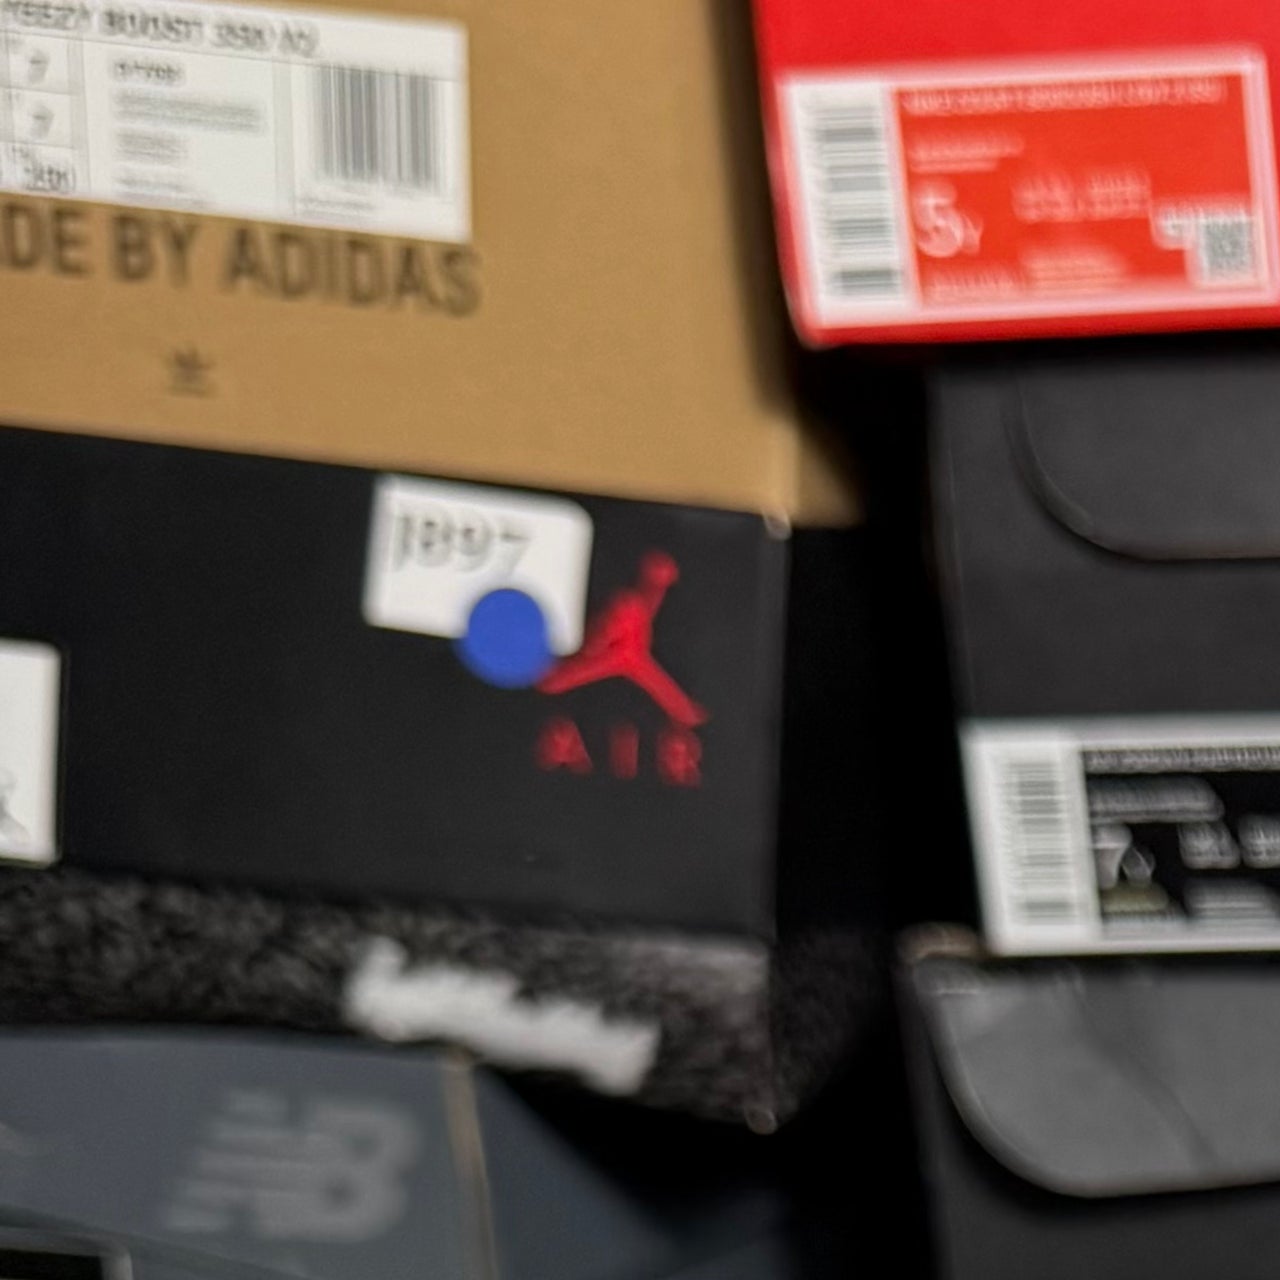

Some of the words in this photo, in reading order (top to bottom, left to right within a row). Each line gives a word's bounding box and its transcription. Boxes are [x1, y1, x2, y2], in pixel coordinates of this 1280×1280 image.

[112, 212, 198, 287] BY
[221, 226, 483, 318] ADIDAS
[536, 716, 702, 787] AIR
